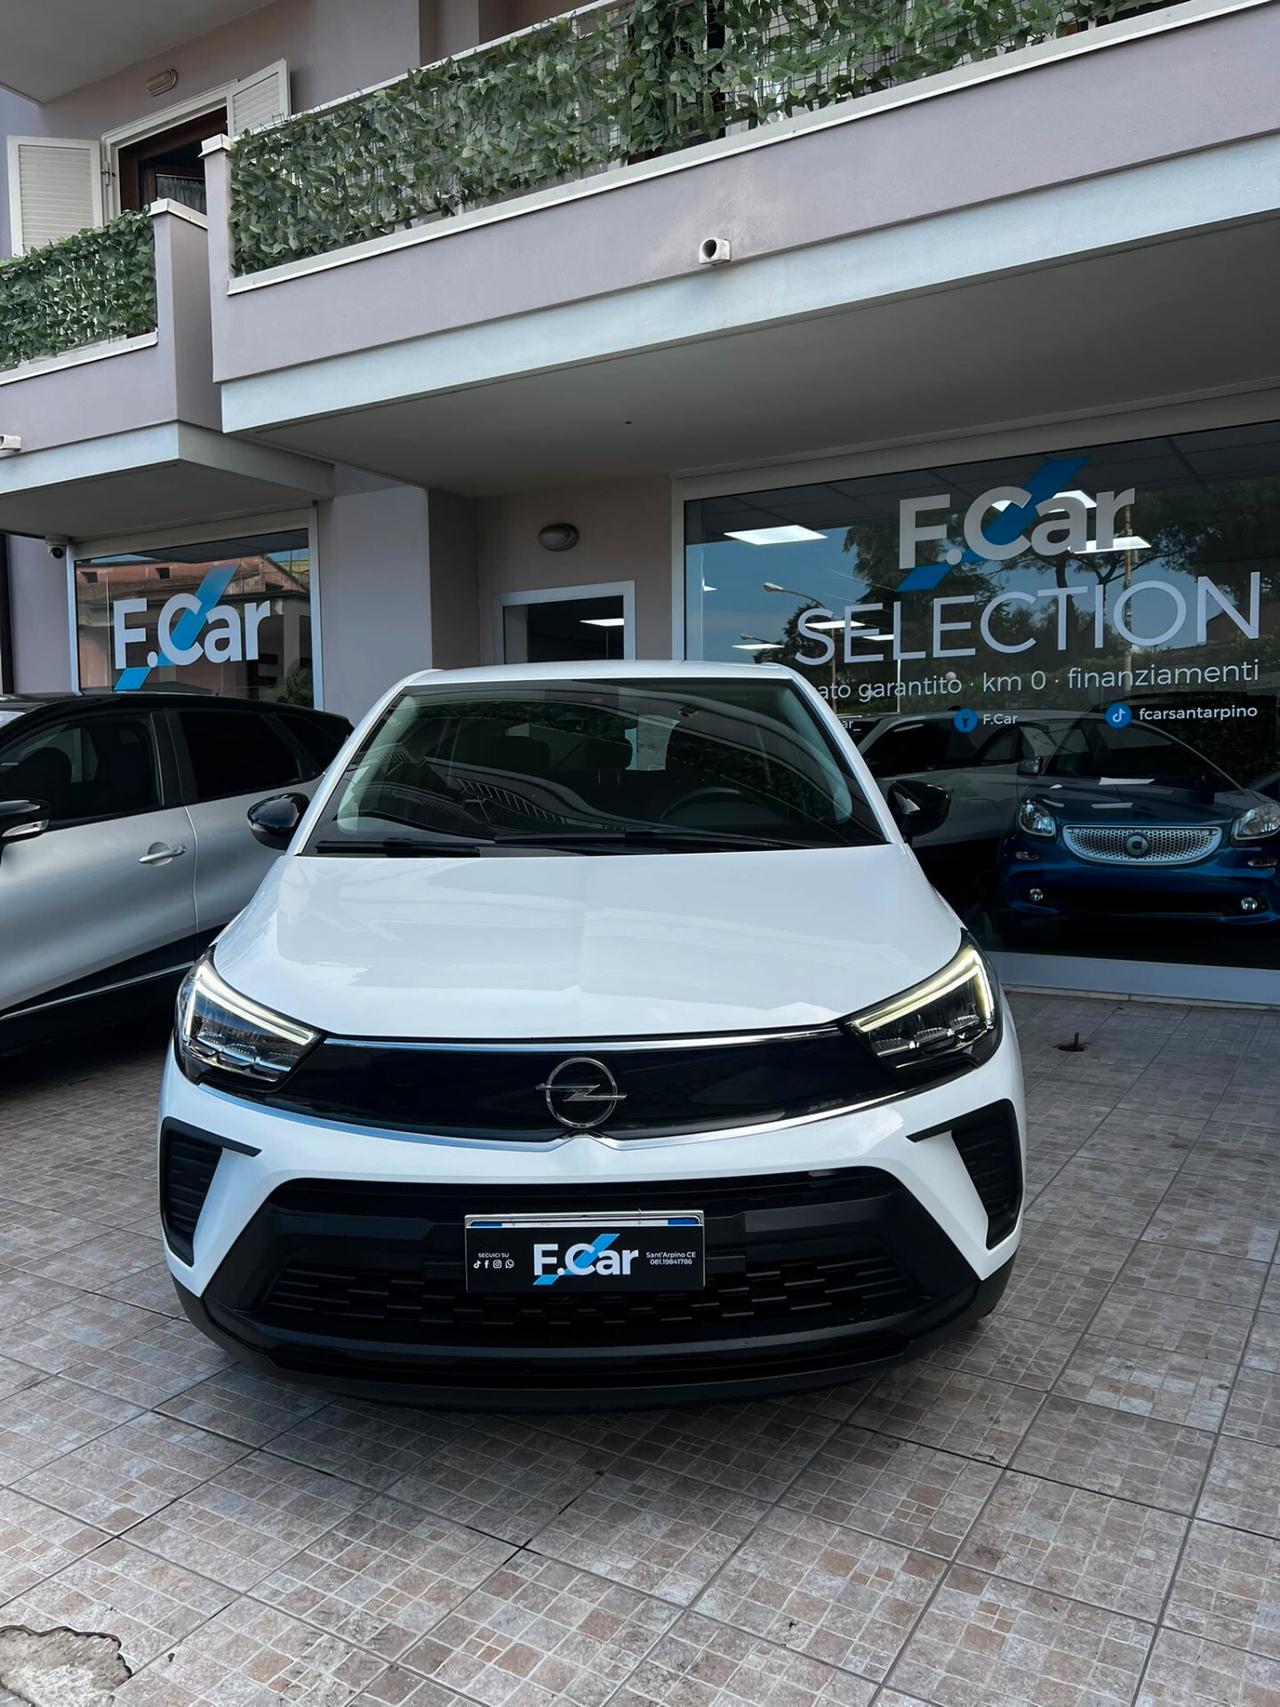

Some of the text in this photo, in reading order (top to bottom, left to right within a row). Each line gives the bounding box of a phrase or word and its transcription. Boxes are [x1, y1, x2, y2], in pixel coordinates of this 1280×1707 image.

[899, 485, 1136, 571] F.Car
[113, 593, 271, 670] F.Car
[794, 571, 1262, 666] SELECTION
[858, 675, 962, 703] garantito
[982, 672, 1022, 692] km
[1030, 670, 1047, 690] 0
[1067, 658, 1260, 690] finanziamenti
[982, 713, 1018, 726] F.Car
[1138, 706, 1258, 721] fcarsantarpino
[533, 1243, 639, 1276] F.Car
[646, 1251, 686, 1259] Sant'Arpino
